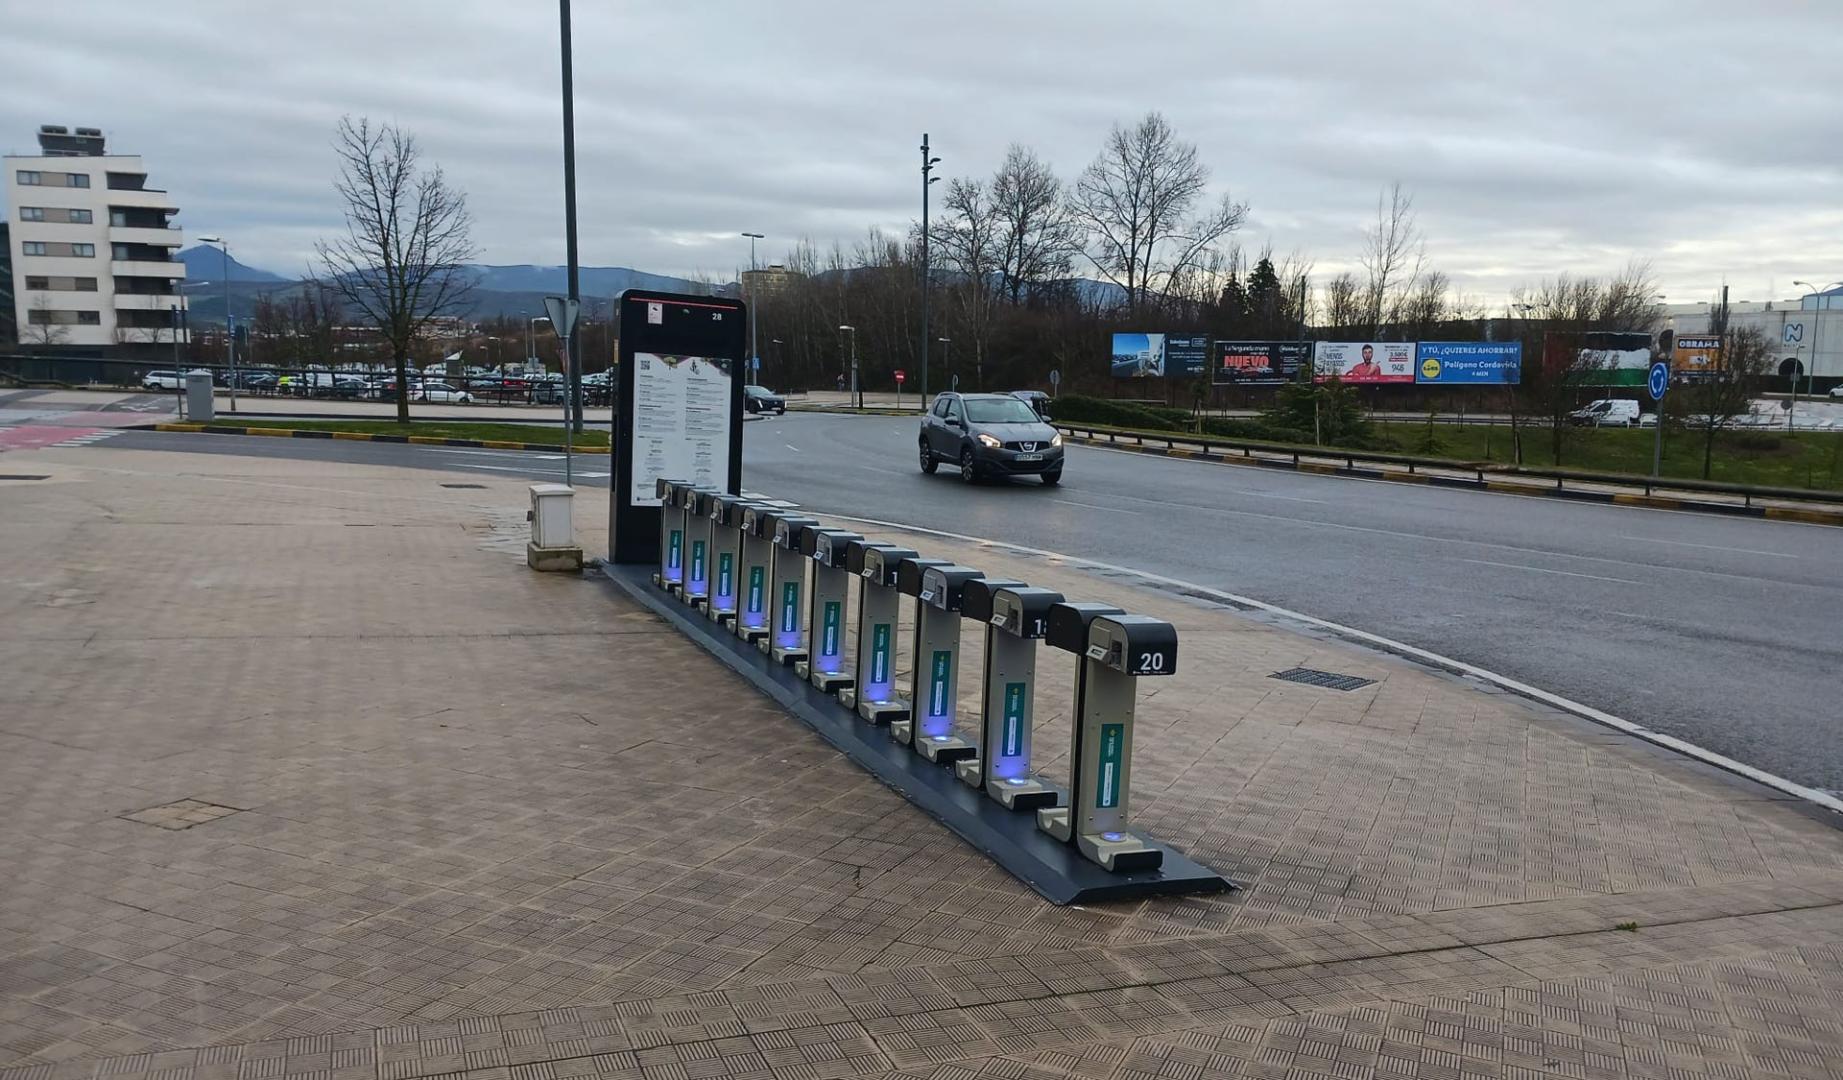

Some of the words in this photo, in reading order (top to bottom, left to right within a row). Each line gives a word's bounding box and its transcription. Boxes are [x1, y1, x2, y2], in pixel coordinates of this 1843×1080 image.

[711, 312, 722, 321] 28
[1440, 347, 1475, 355] ¿QUIERES
[1224, 355, 1270, 368] NUEVO
[1444, 361, 1477, 370] Polígono
[1140, 652, 1164, 671] 20
